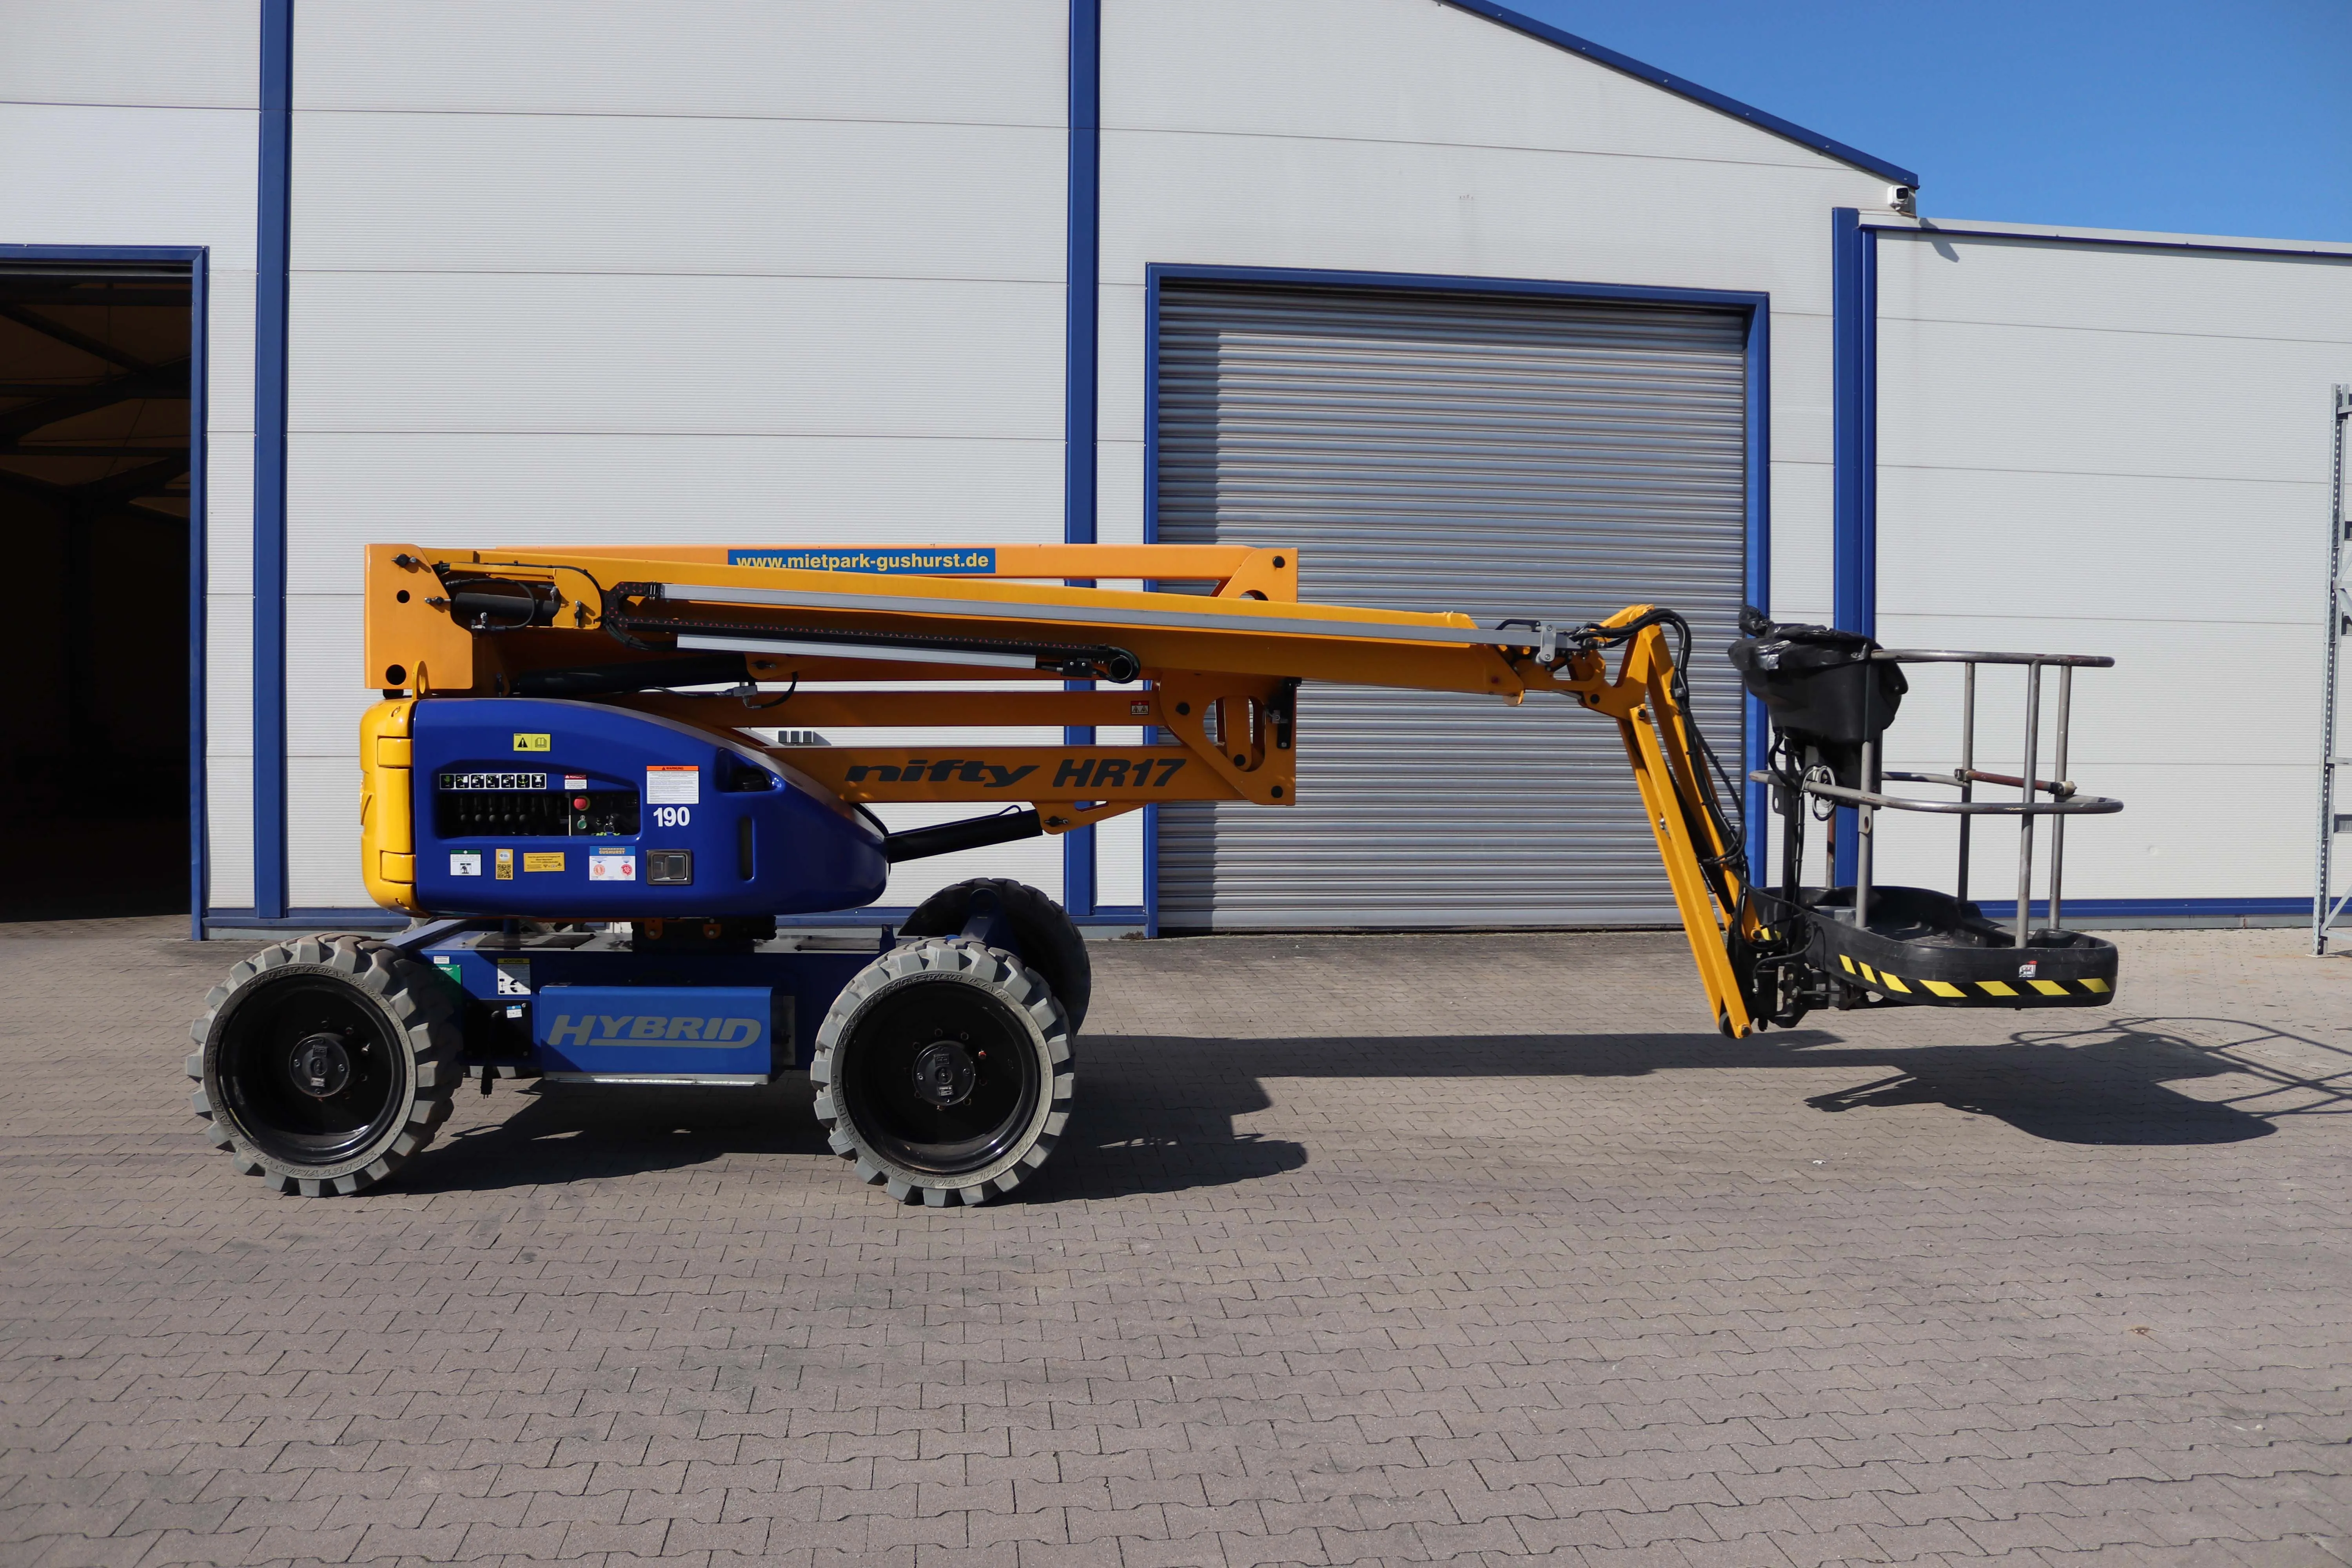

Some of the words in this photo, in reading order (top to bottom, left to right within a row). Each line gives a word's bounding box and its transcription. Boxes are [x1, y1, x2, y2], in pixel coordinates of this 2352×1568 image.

[736, 553, 989, 572] www.mietpark-gushurst.de
[844, 759, 1041, 788] nifty
[1052, 759, 1187, 787] HR17
[653, 806, 690, 827] 190
[839, 972, 962, 1049] SAFETYMASTER
[547, 1014, 761, 1049] HYBRID
[833, 1080, 861, 1143] SOLIDEAL
